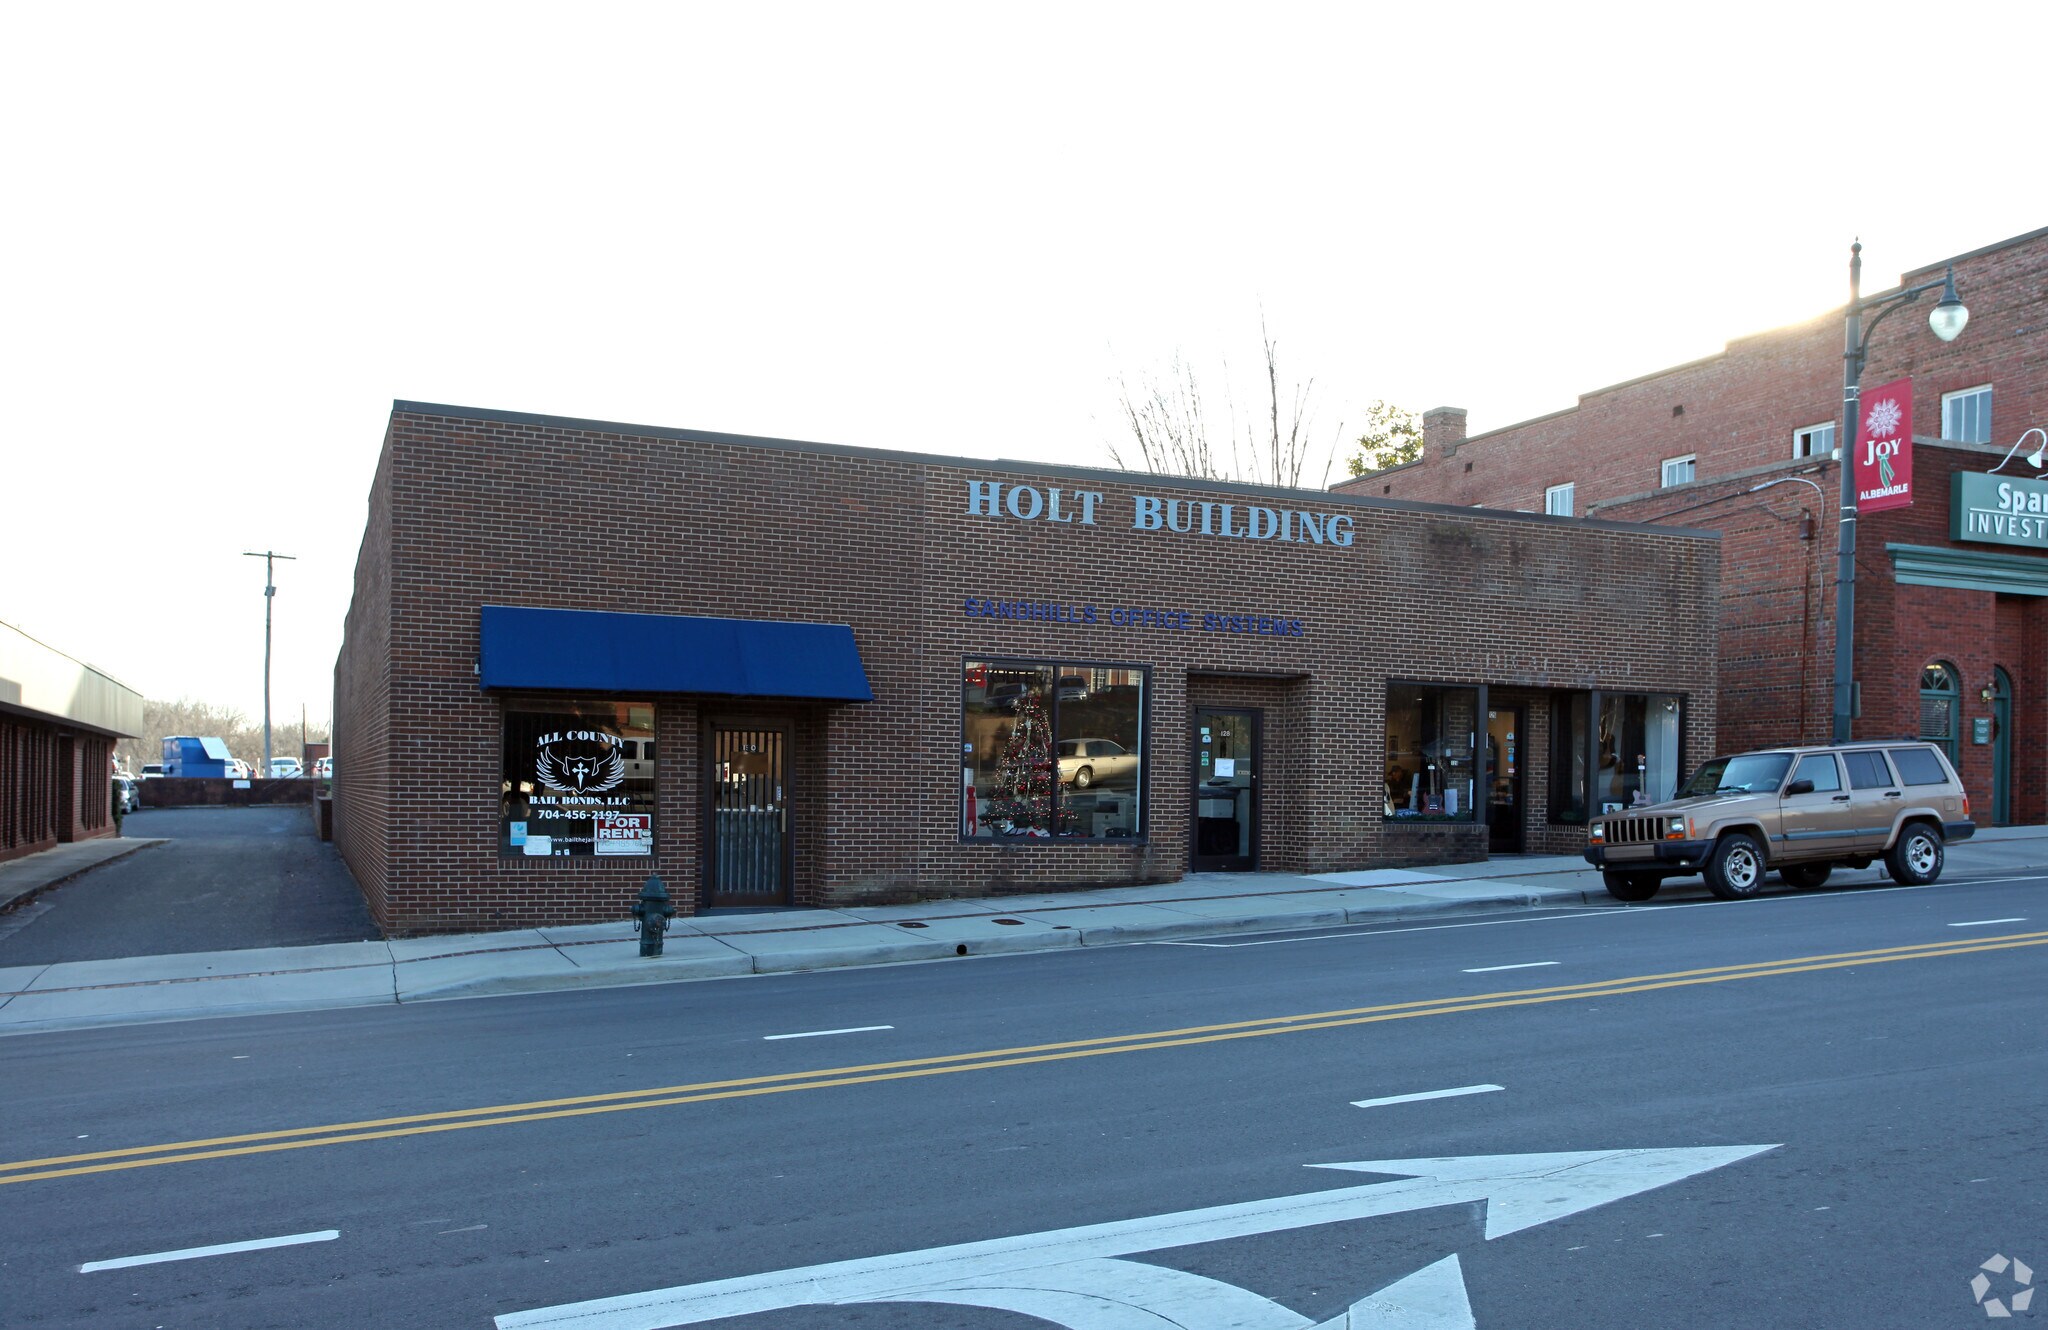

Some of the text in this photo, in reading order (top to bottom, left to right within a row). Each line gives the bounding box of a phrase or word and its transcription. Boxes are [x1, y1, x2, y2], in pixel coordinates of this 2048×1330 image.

[1863, 438, 1902, 466] JOY
[1860, 483, 1908, 500] ALBEMARLE
[965, 480, 1355, 547] HOLT BUILDING
[965, 598, 1303, 636] SANDHILLS OFFICE SYSTEMS
[536, 730, 624, 749] ALL COUNTY
[529, 796, 559, 805] BAIL
[607, 797, 631, 806] LLC
[538, 810, 620, 820] 704-456-2197
[605, 817, 640, 828] FOR
[600, 828, 645, 839] RENT
